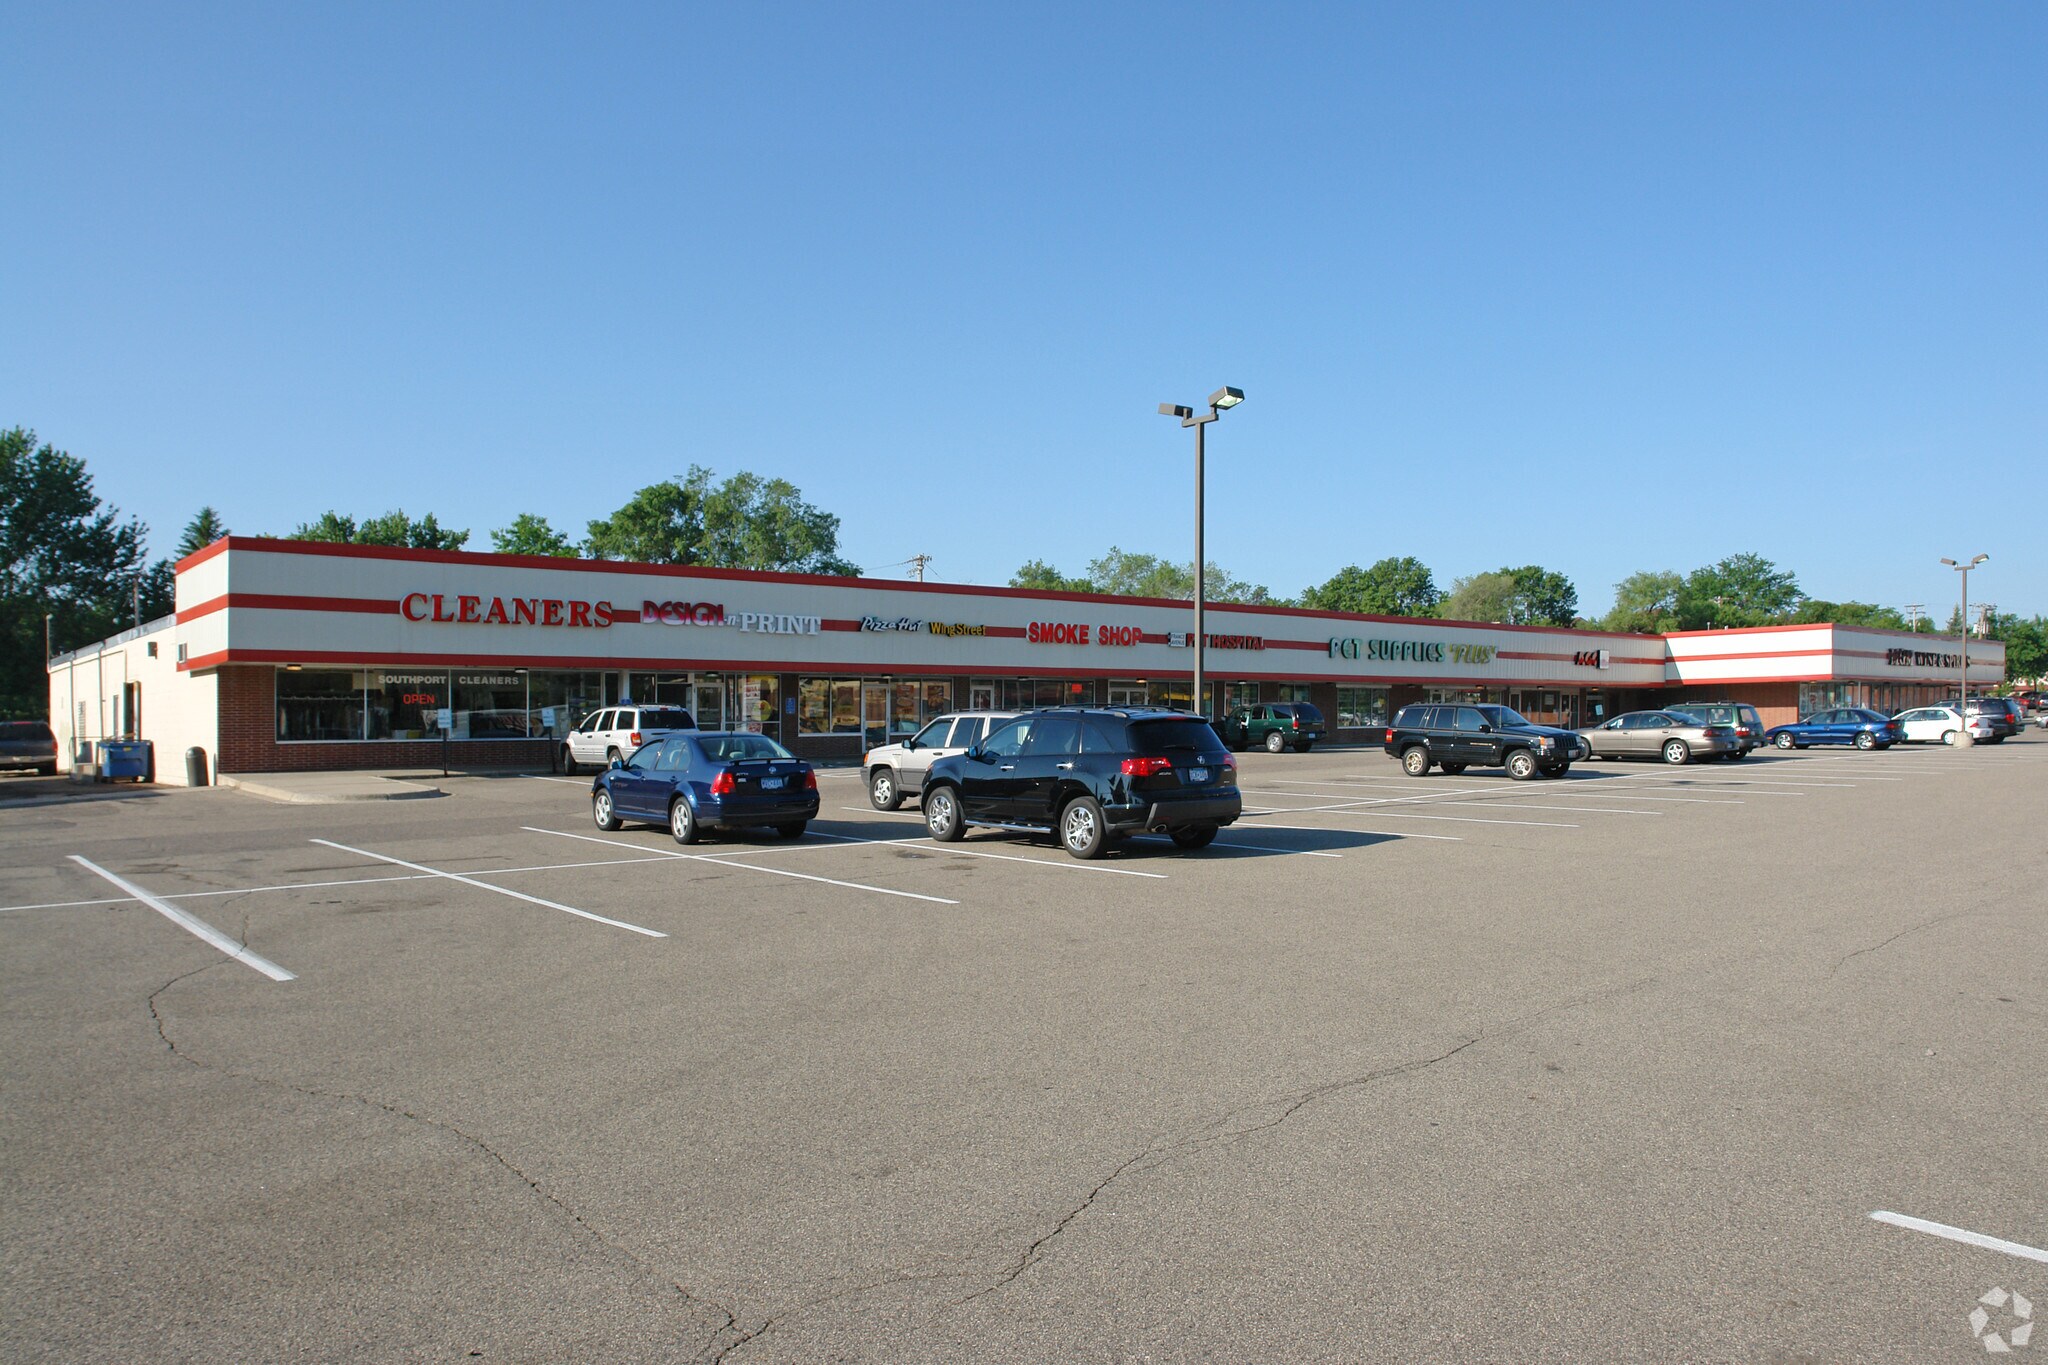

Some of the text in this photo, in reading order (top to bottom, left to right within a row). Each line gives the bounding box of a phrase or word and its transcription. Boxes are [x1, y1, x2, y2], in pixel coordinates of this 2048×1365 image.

[401, 592, 613, 628] CLEANERS
[643, 600, 723, 626] DESIGN
[739, 612, 821, 636] PRINT
[861, 616, 922, 632] Pizza Hut
[929, 621, 986, 638] WingStreet
[1027, 620, 1142, 646] SMOKE SHOP
[1187, 633, 1265, 650] PT HOSPITAL
[1329, 637, 1362, 660] PET
[1368, 638, 1445, 663] SUPPLIES
[378, 676, 519, 685] SOUTHPORT CLEANERS
[403, 694, 435, 704] OPEN
